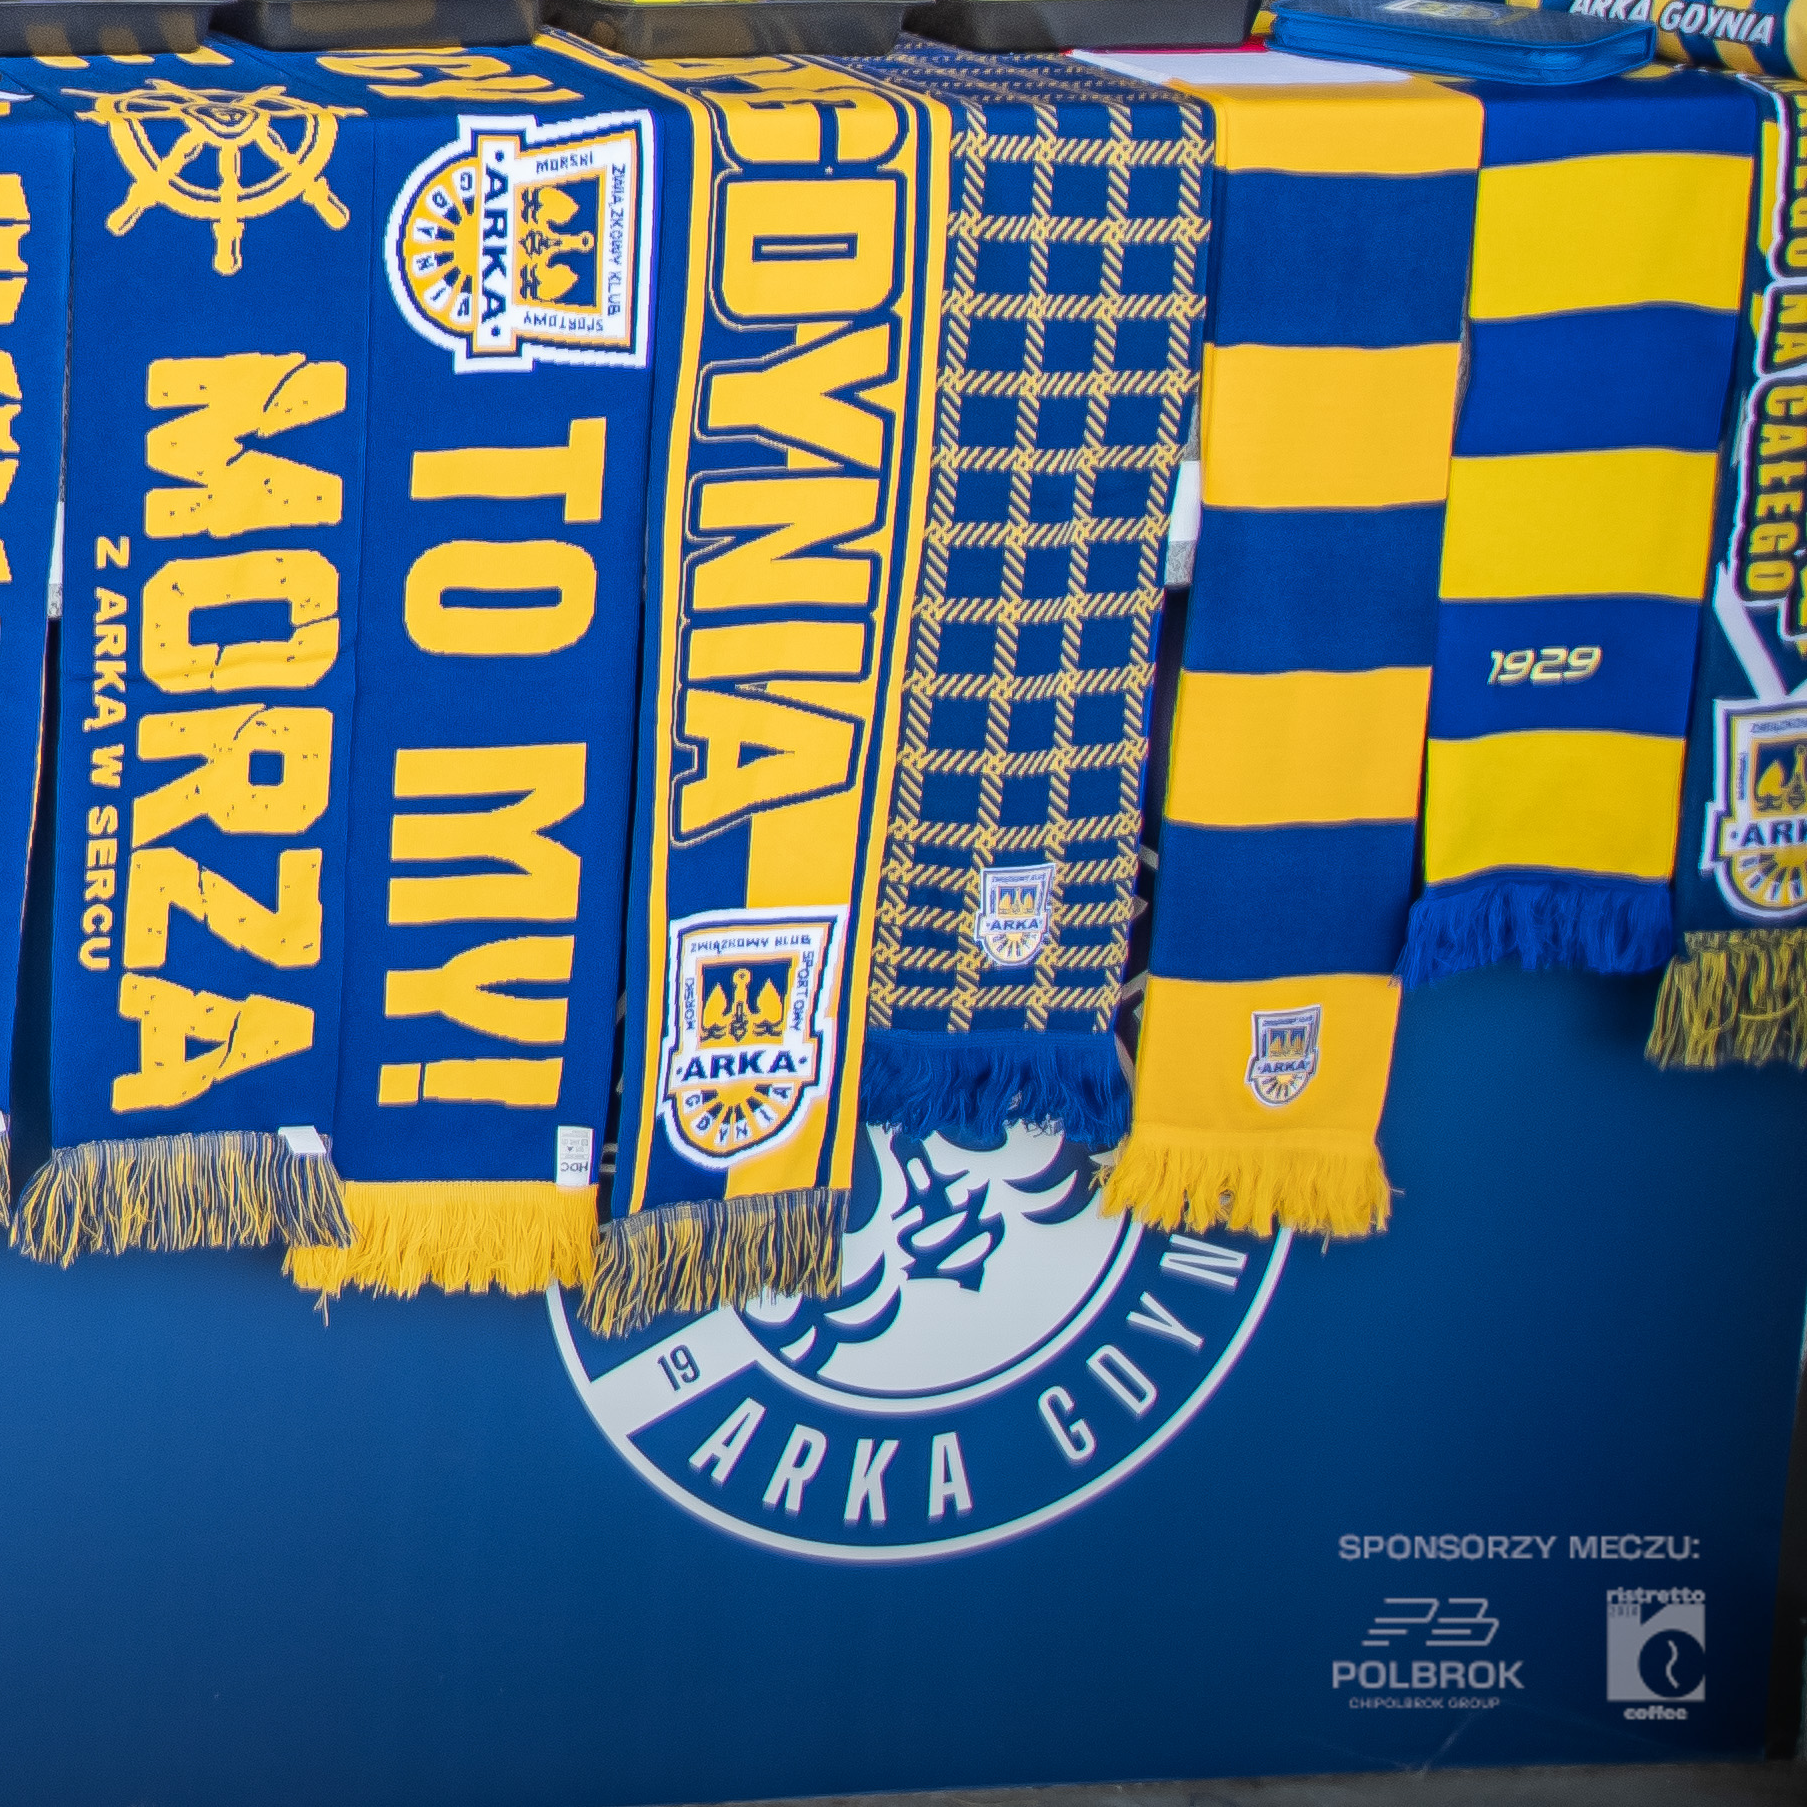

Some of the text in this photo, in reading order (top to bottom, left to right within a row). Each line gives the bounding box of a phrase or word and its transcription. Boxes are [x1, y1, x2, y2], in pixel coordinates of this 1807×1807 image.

[1661, 1, 1776, 45] GDYNIA
[537, 151, 594, 172] MORSKI
[411, 170, 473, 319] GDYNIA
[480, 173, 508, 324] ARKA
[1487, 645, 1602, 686] 1929
[79, 536, 131, 972] Z ARKĄ W SERCU
[111, 352, 348, 1115] MORZA
[377, 416, 607, 1109] TO MY!
[774, 933, 813, 950] KLUB
[989, 917, 1042, 933] ARKA
[680, 1048, 799, 1079] ARKA
[1257, 1060, 1309, 1074] ARKA
[683, 1083, 794, 1144] GDYNIA
[655, 1341, 702, 1393] 19
[688, 1233, 1251, 1524] ARKA GDYN
